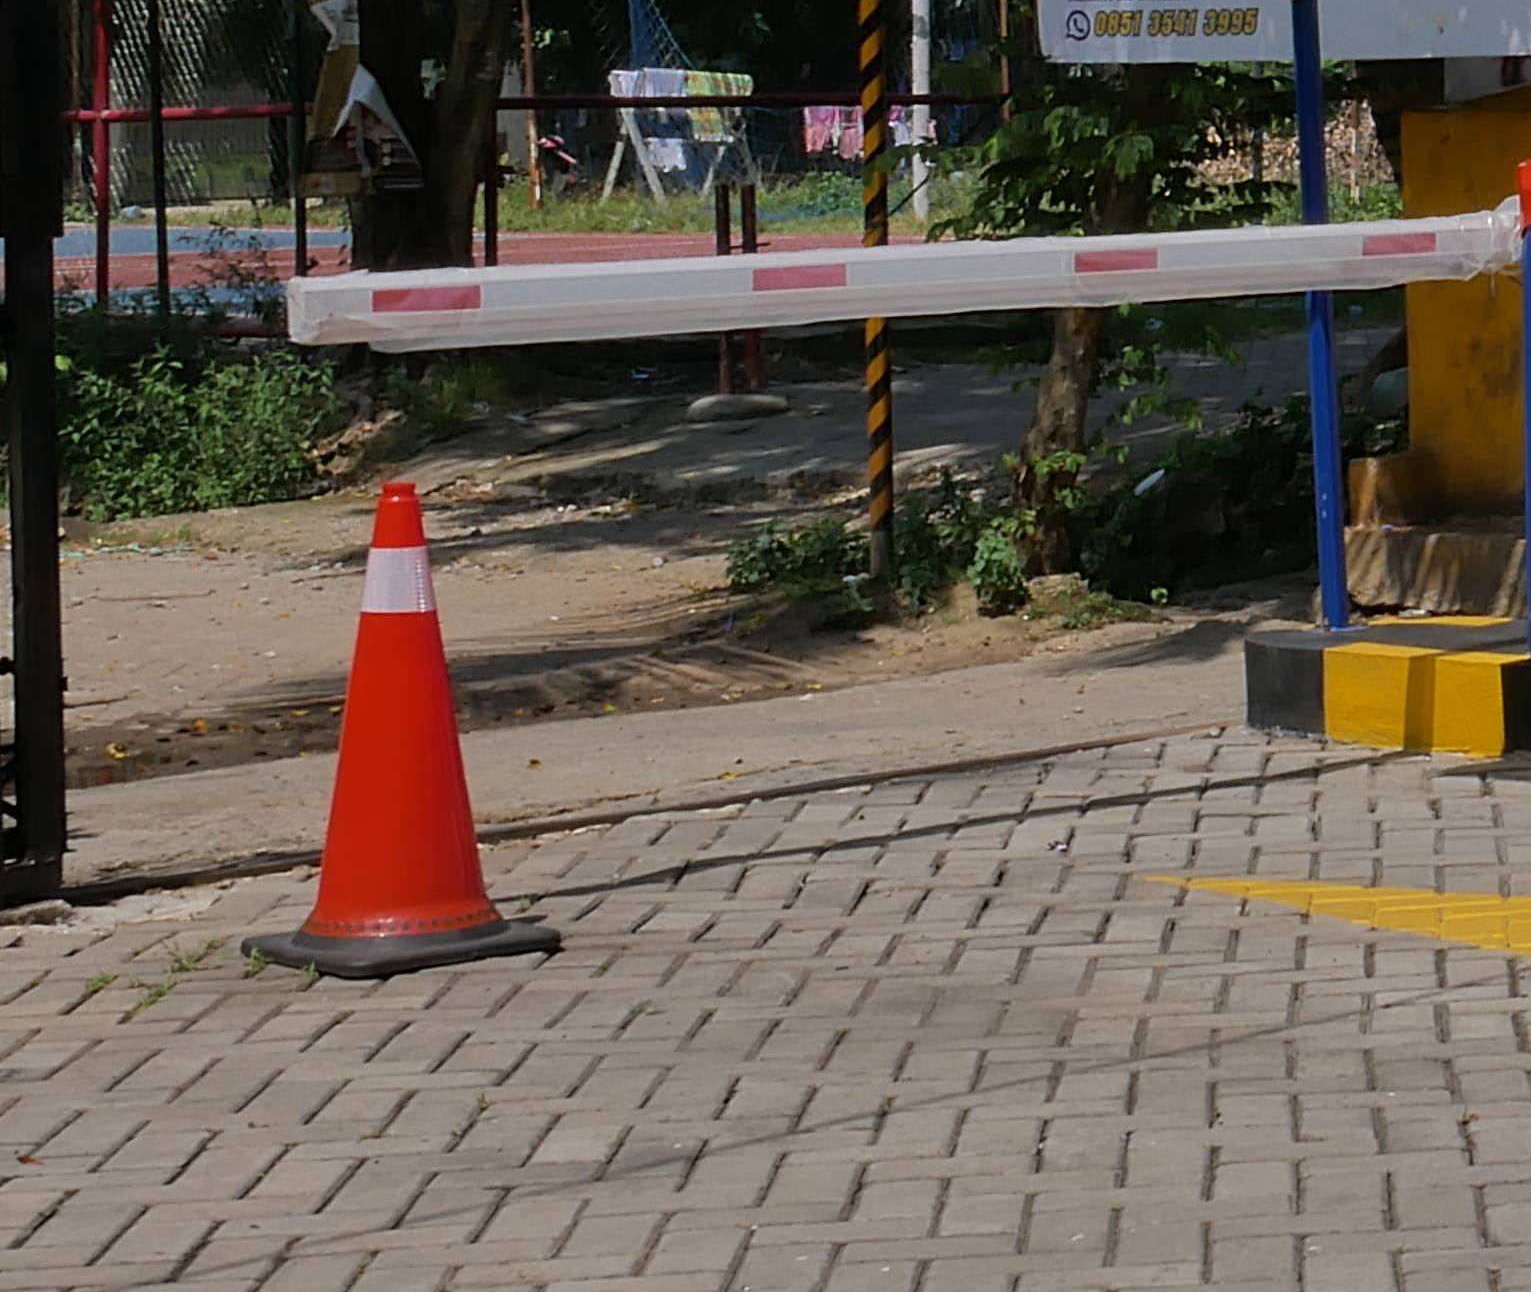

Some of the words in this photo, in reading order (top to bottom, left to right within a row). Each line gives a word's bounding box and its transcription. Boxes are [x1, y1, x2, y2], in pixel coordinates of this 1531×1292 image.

[1094, 10, 1143, 37] 0851
[1147, 9, 1199, 36] 3541
[1202, 7, 1259, 36] 3995
